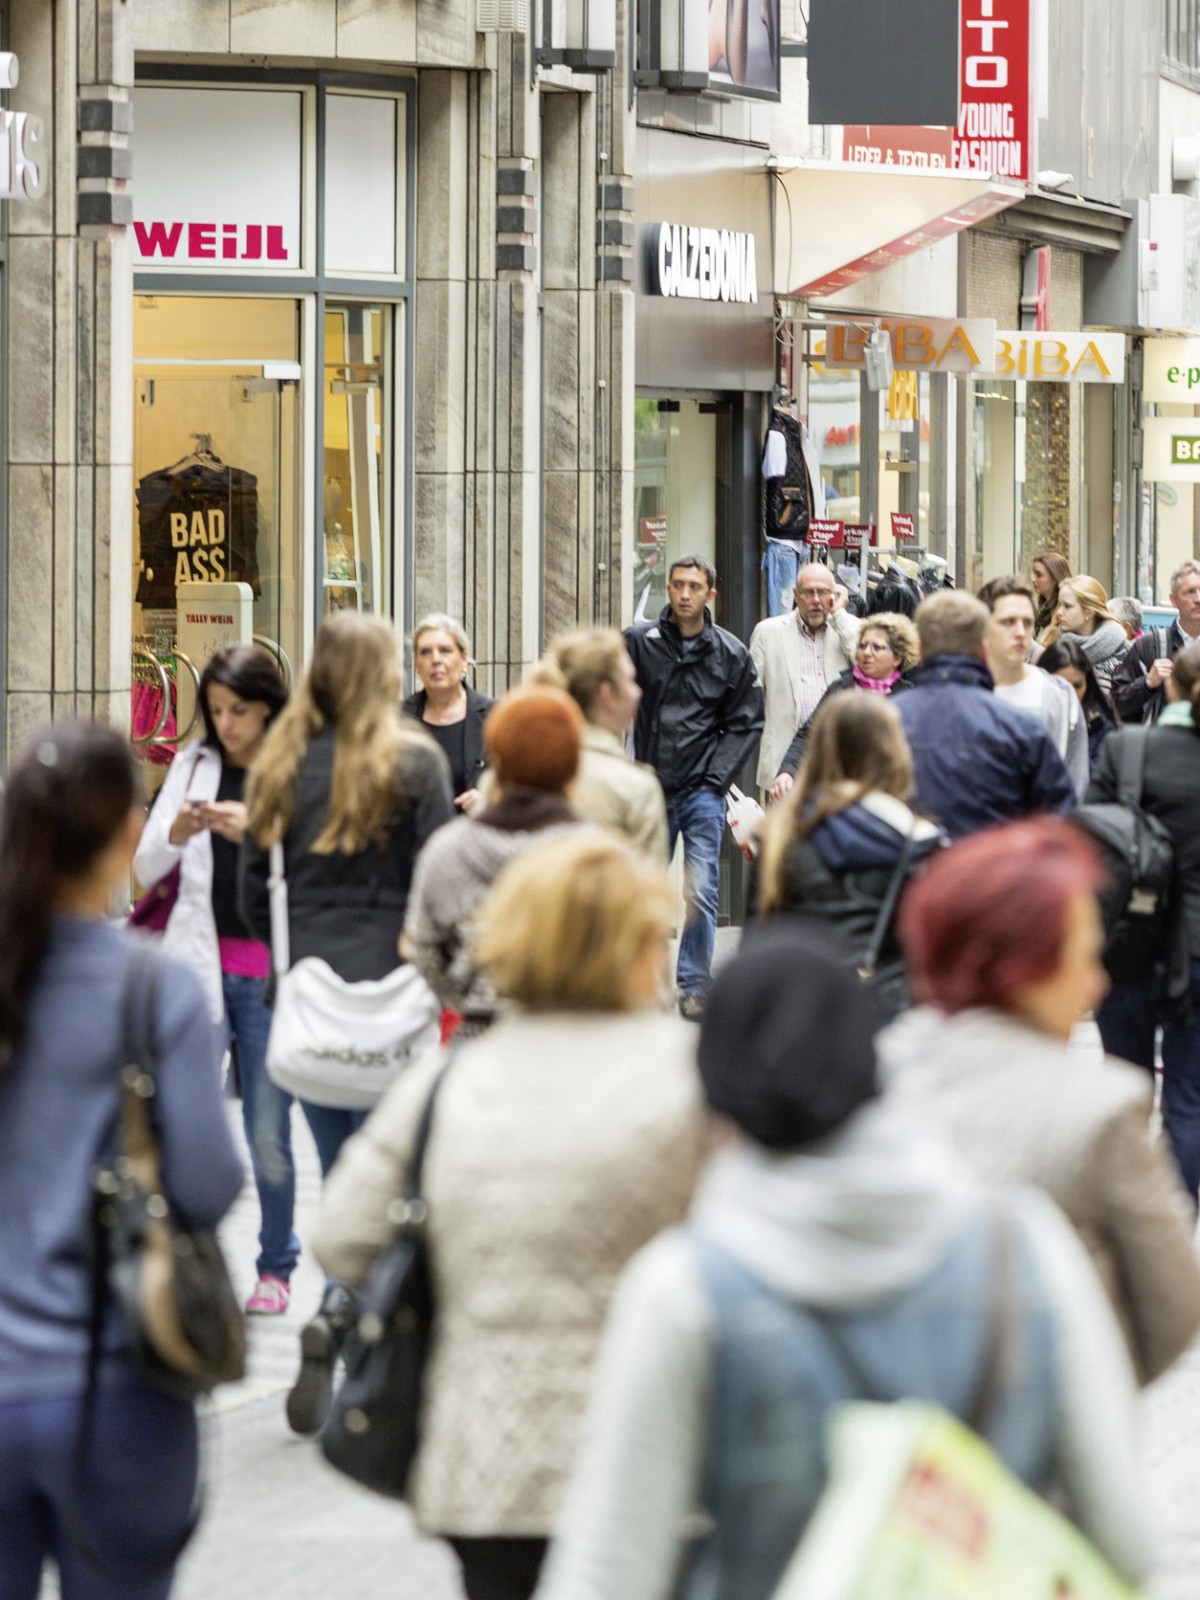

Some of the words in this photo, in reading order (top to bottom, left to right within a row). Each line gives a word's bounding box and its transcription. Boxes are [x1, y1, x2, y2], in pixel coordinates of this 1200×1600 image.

[957, 103, 1014, 138] YOUNG
[951, 140, 1021, 176] FASHION
[659, 221, 758, 304] CALZEDONIA
[170, 509, 225, 548] BAD
